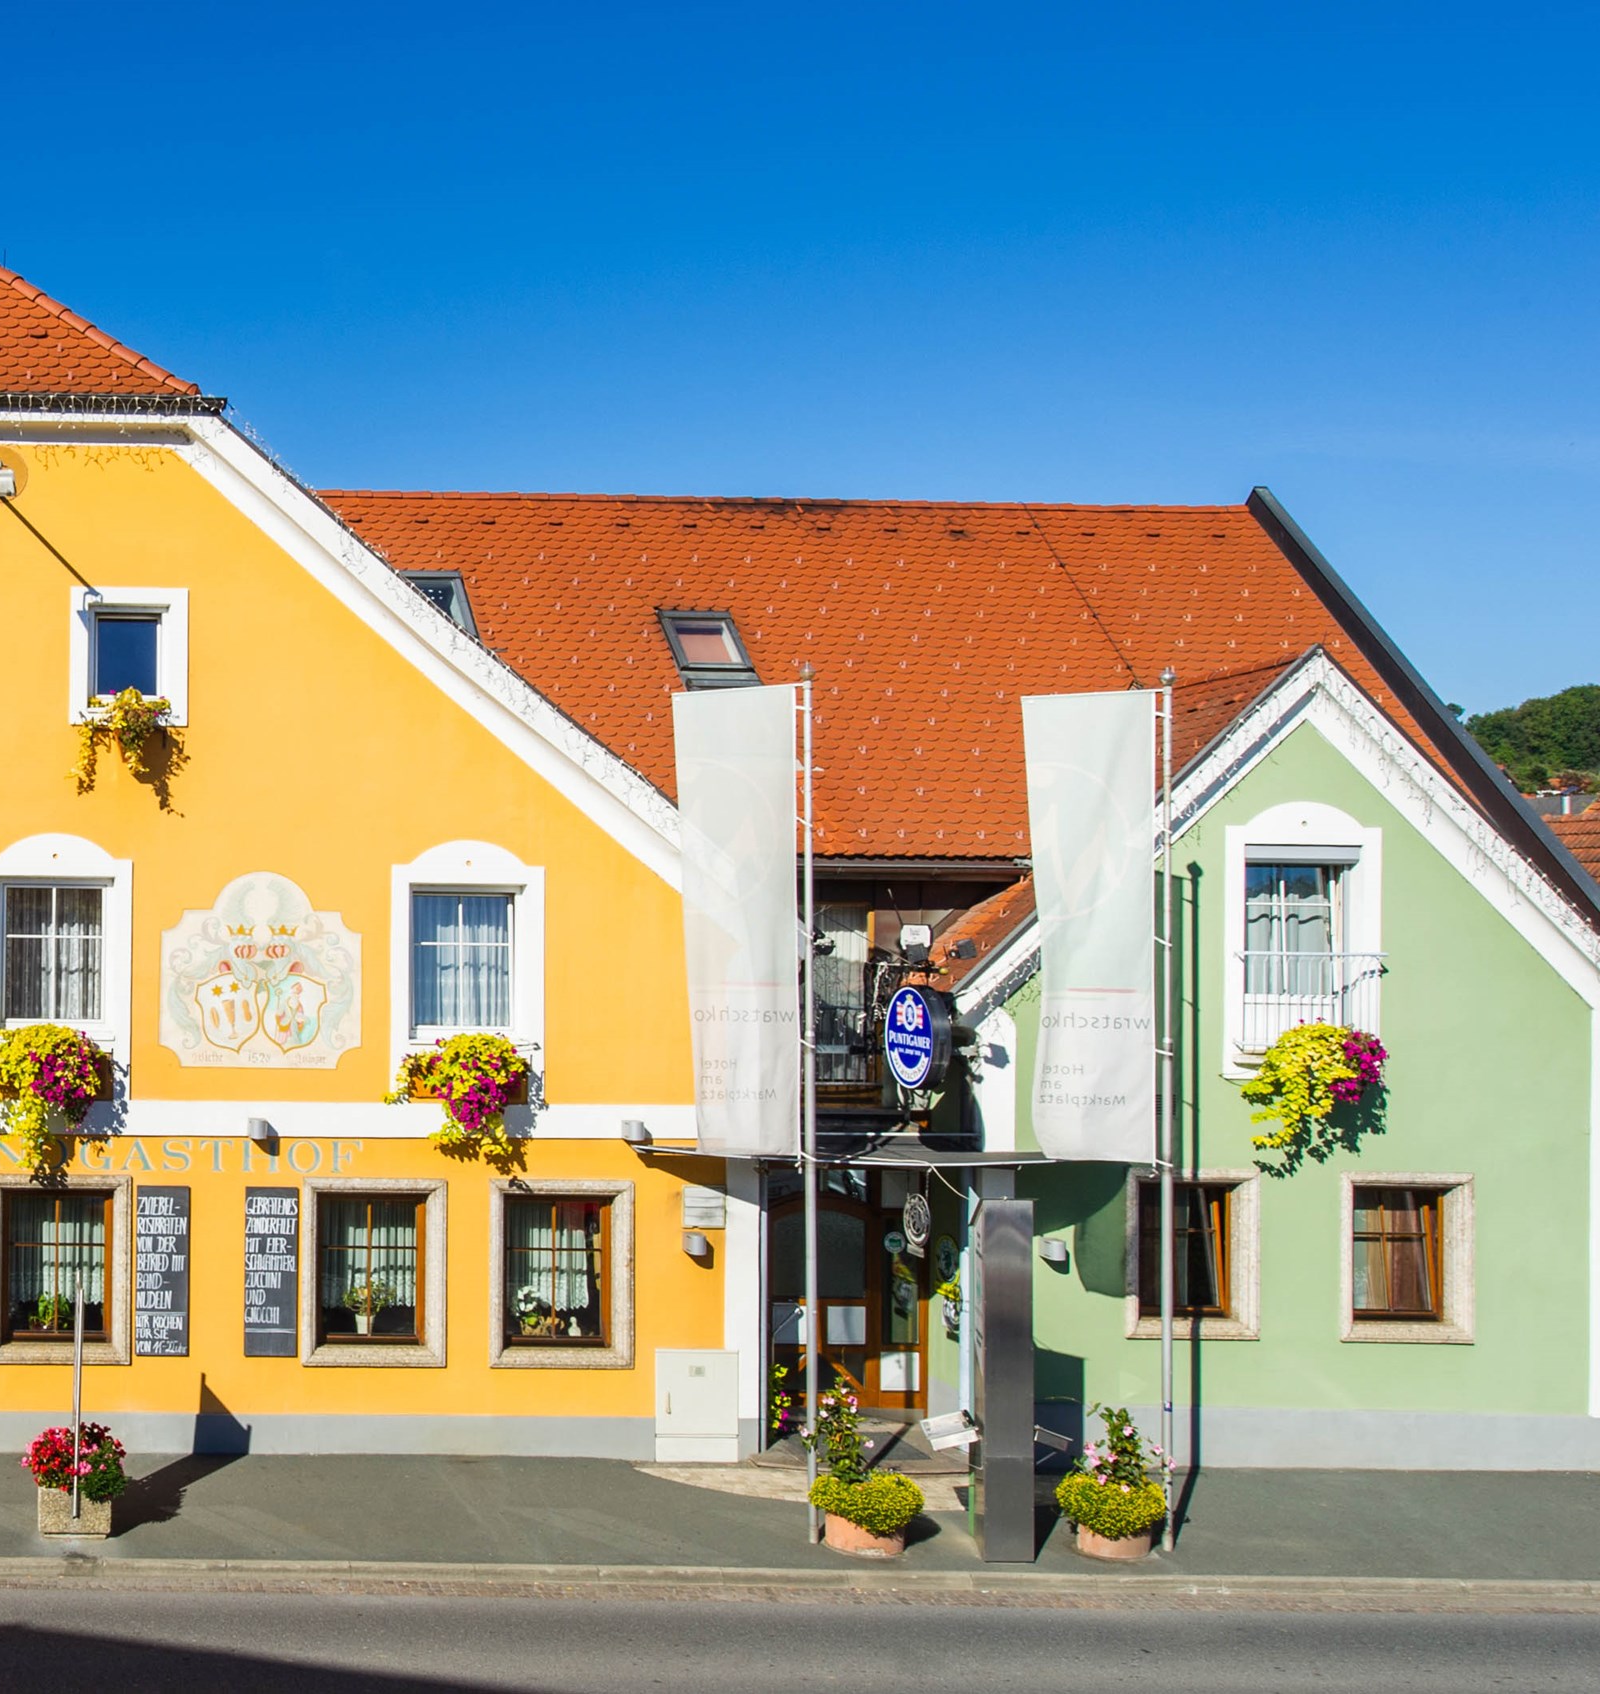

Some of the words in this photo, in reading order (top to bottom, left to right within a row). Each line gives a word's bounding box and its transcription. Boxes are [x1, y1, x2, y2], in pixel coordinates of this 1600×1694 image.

[137, 1196, 181, 1216] ZWIEBEL-
[137, 1216, 188, 1235] ROSTBRATEN
[137, 1236, 153, 1253] VON
[156, 1236, 177, 1253] DER
[245, 1237, 261, 1253] MIT
[266, 1237, 293, 1254] EIER-
[171, 1254, 187, 1272] MIT
[137, 1272, 171, 1290] BAND-
[137, 1290, 173, 1310] NUDELN
[245, 1289, 266, 1305] UND
[136, 1315, 150, 1328] WIR
[152, 1316, 183, 1331] KOCHEN
[153, 1328, 169, 1339] SIE
[136, 1340, 152, 1354] VON
